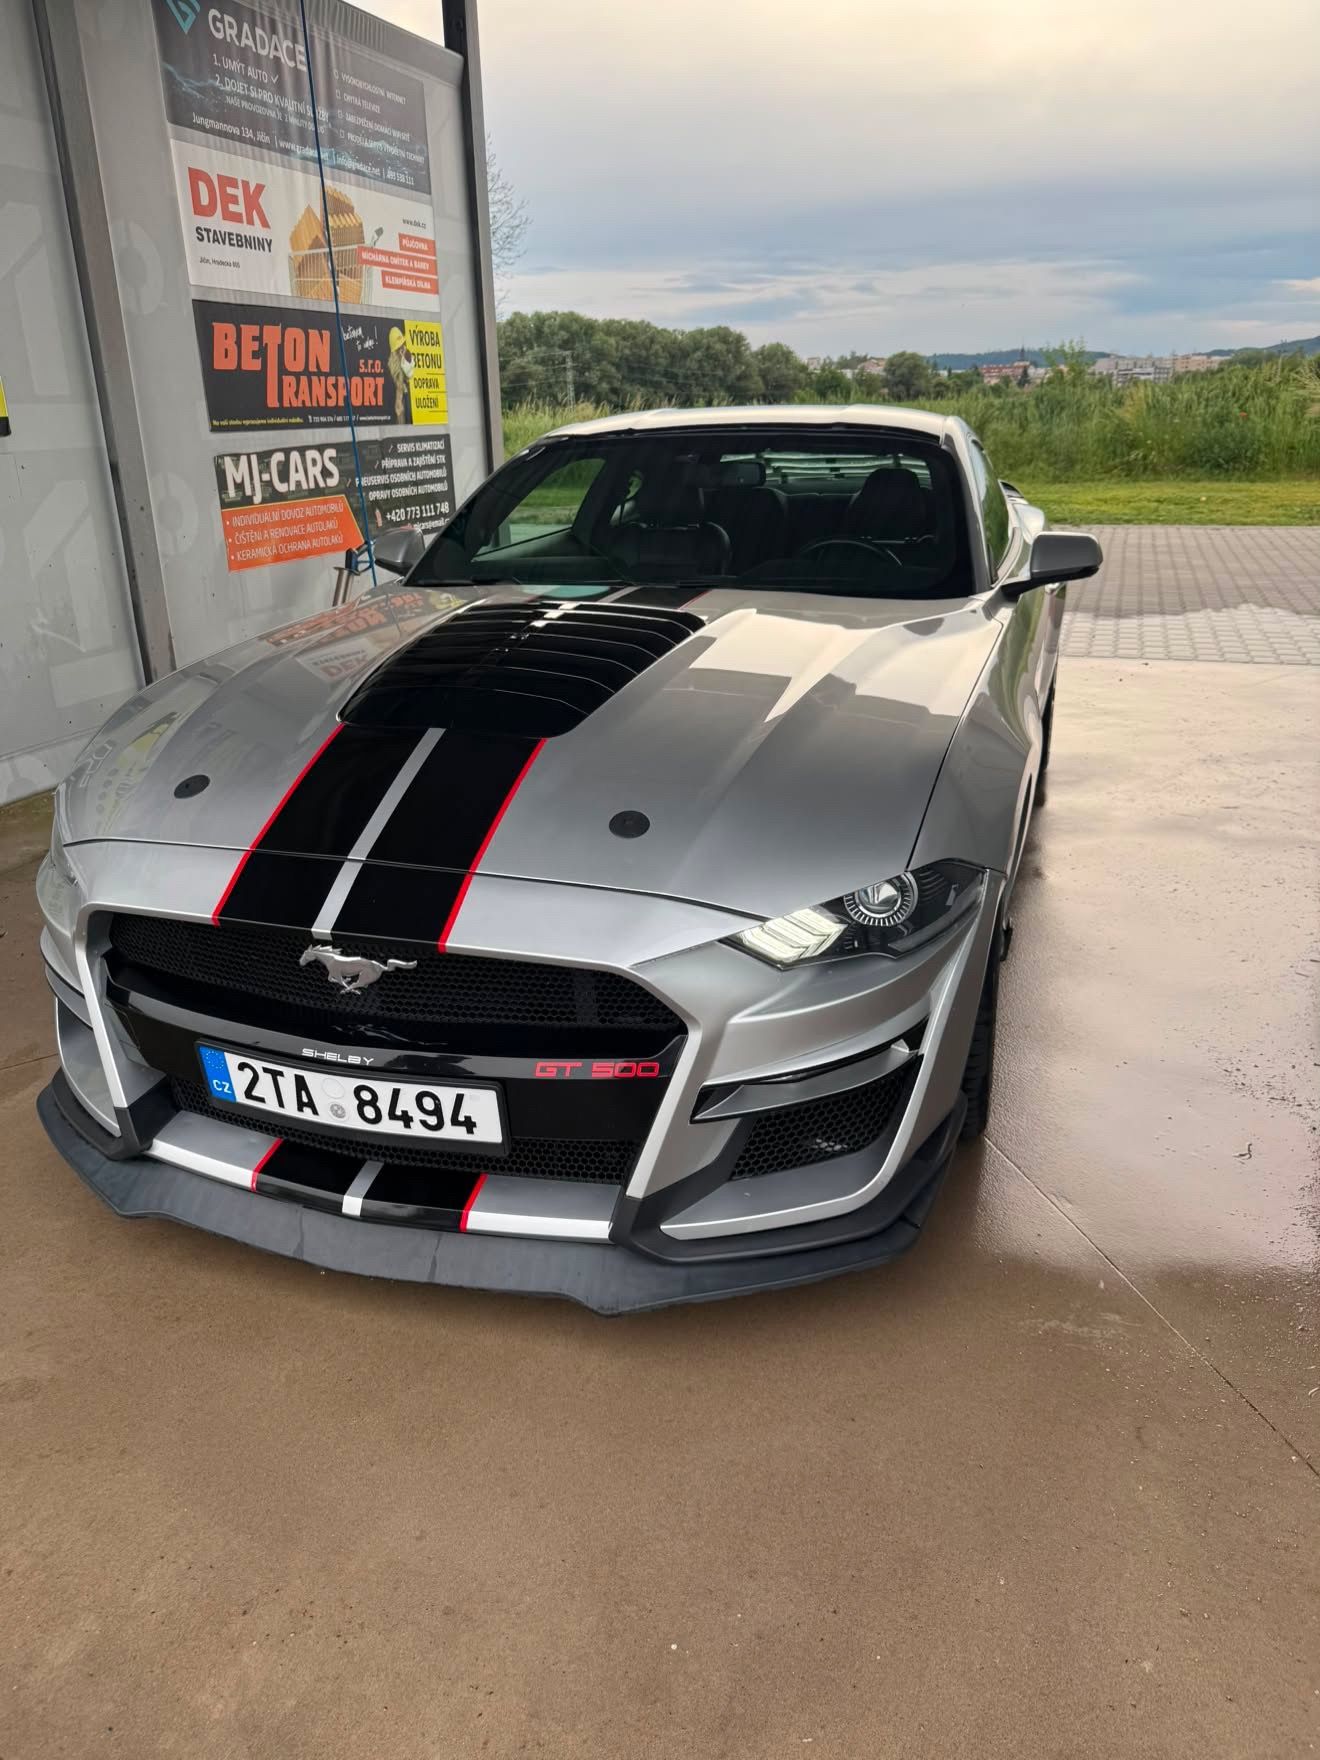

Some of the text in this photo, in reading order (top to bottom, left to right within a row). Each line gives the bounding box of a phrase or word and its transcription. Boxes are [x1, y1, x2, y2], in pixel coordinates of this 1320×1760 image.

[208, 8, 307, 72] GRADACE
[222, 56, 245, 76] UMÝT
[248, 65, 268, 83] AUTO
[224, 76, 249, 96] DOJET
[258, 87, 274, 104] PRO
[192, 112, 240, 136] Jungmannova
[188, 166, 271, 230] DEK
[195, 226, 273, 253] STAVEBNINY
[212, 322, 331, 374] BETON
[409, 325, 441, 348] VÝROBA
[359, 359, 384, 373] s.r.o.
[412, 352, 442, 369] BETONU
[413, 378, 440, 390] DOPRAVA
[396, 438, 445, 453] SERVIS KLIMATIZACÍ
[381, 452, 446, 469] PŘÍPRAVA A ZAJIŠTĚNÍ STK
[224, 448, 340, 504] MJ-CARS
[390, 470, 417, 482] OSOBNÍCH
[417, 465, 448, 480] AUTOMOBILŮ
[368, 479, 449, 501] OPRAVY OSOBNÍCH AUTOMOBILŮ
[281, 508, 305, 521] DOVOZ
[305, 499, 344, 517] AUTOMOBILŮ
[386, 501, 450, 522] +420 773 111 748
[264, 530, 270, 541] A
[270, 525, 306, 540] RENOVACE
[306, 517, 339, 533] AUTOLAKŮ
[279, 540, 311, 555] OCHRANA
[312, 531, 344, 549] AUTOLAKŮ
[302, 1048, 375, 1066] SHELBY
[535, 1061, 660, 1078] GT 500
[212, 1061, 477, 1135] CZ 2TA 8494
